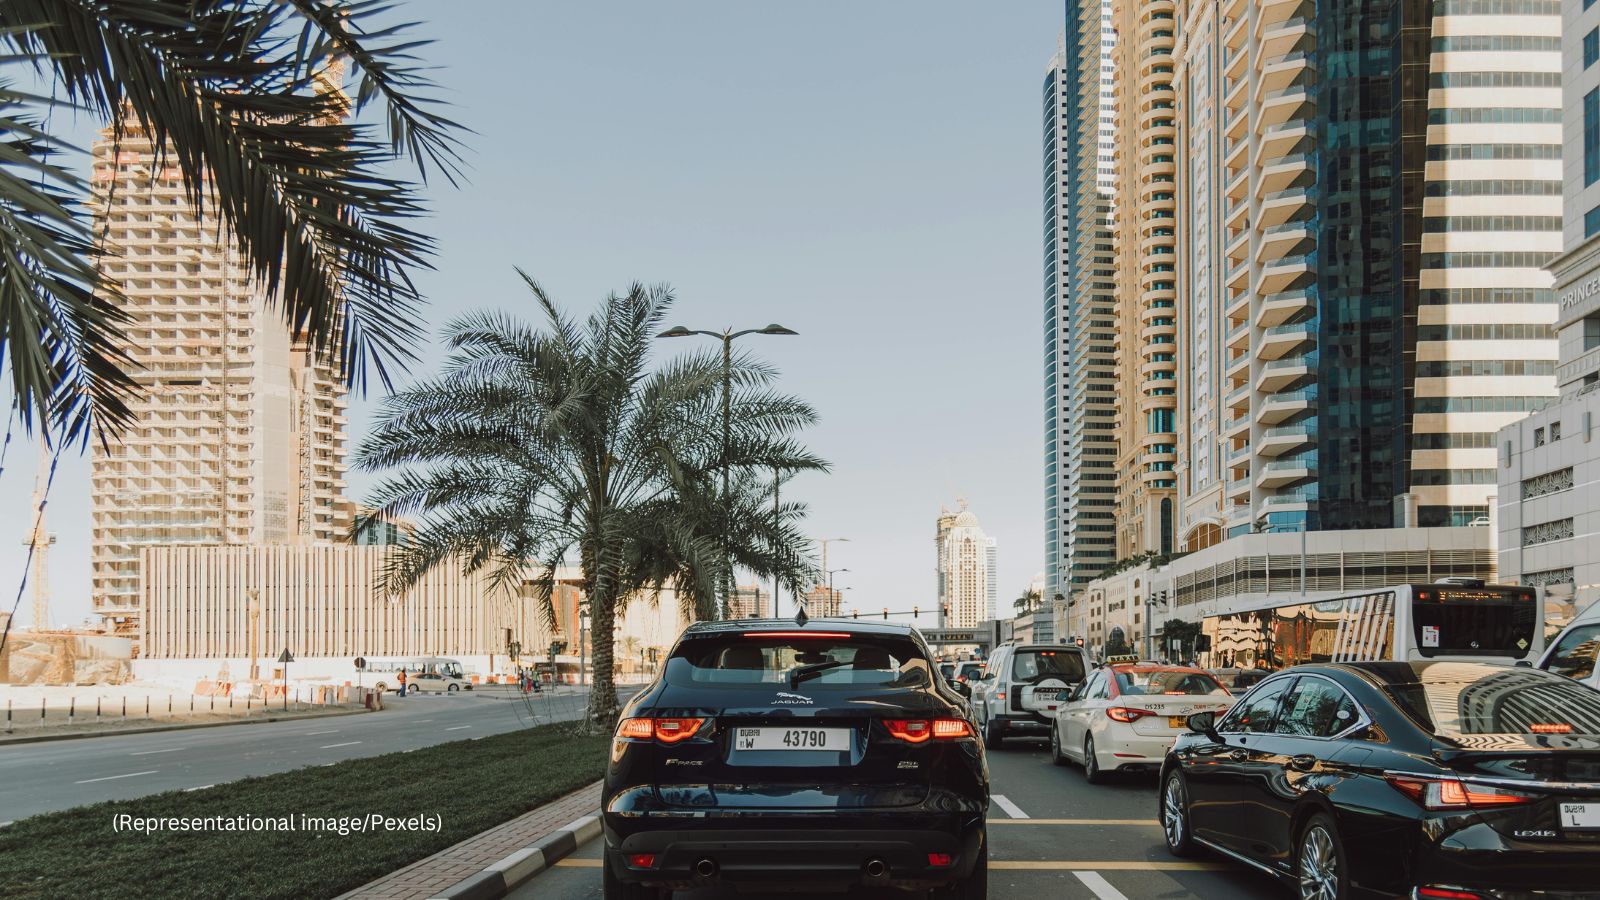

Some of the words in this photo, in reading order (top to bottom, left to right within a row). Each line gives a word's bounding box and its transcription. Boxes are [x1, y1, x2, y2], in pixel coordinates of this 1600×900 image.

[1561, 277, 1600, 311] PRINCE
[740, 729, 761, 737] DUBAI
[783, 730, 826, 747] 43790
[746, 738, 754, 749] W
[1564, 805, 1585, 813] DUBAI
[1572, 815, 1581, 826] L
